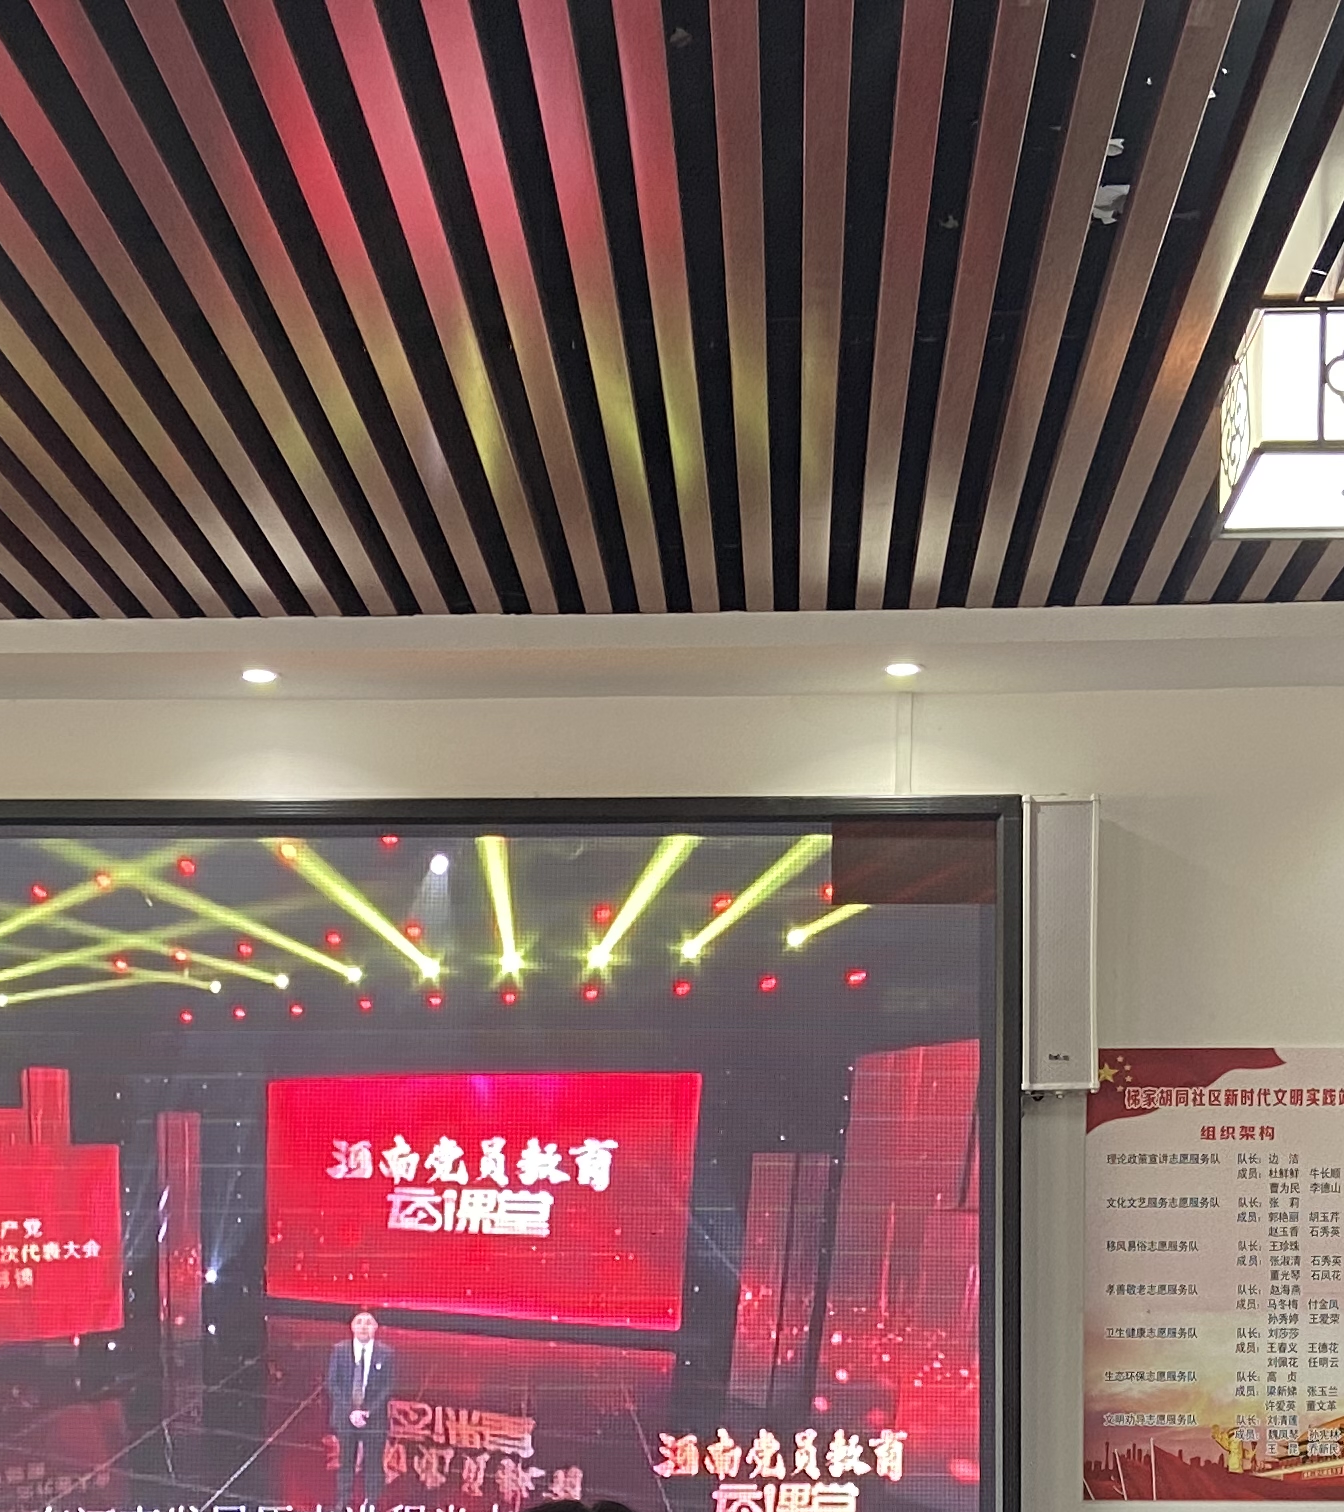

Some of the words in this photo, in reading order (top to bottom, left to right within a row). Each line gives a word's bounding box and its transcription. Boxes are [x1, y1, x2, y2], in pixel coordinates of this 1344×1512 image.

[1200, 1125, 1275, 1140] 组织架构
[326, 1134, 619, 1192] 河南党员教育
[1106, 1153, 1221, 1165] 理论政策宣讲志愿服务队
[1309, 1182, 1341, 1194] 李德山
[1106, 1197, 1220, 1209] 文化文艺服务志愿服务队
[387, 1187, 554, 1237] 云课堂
[1309, 1226, 1341, 1238] 石秀英
[1106, 1240, 1199, 1252] 移风易俗志愿服务队
[1105, 1284, 1198, 1296] 孝善敬老志愿服务队
[1106, 1327, 1198, 1340] 卫生健康志愿服务队
[1104, 1371, 1198, 1383] 生态环保志愿服务队
[1307, 1385, 1339, 1397] 张玉兰
[1103, 1413, 1197, 1426] 文明劝导志愿服务队
[653, 1428, 908, 1482] 河南党员教育
